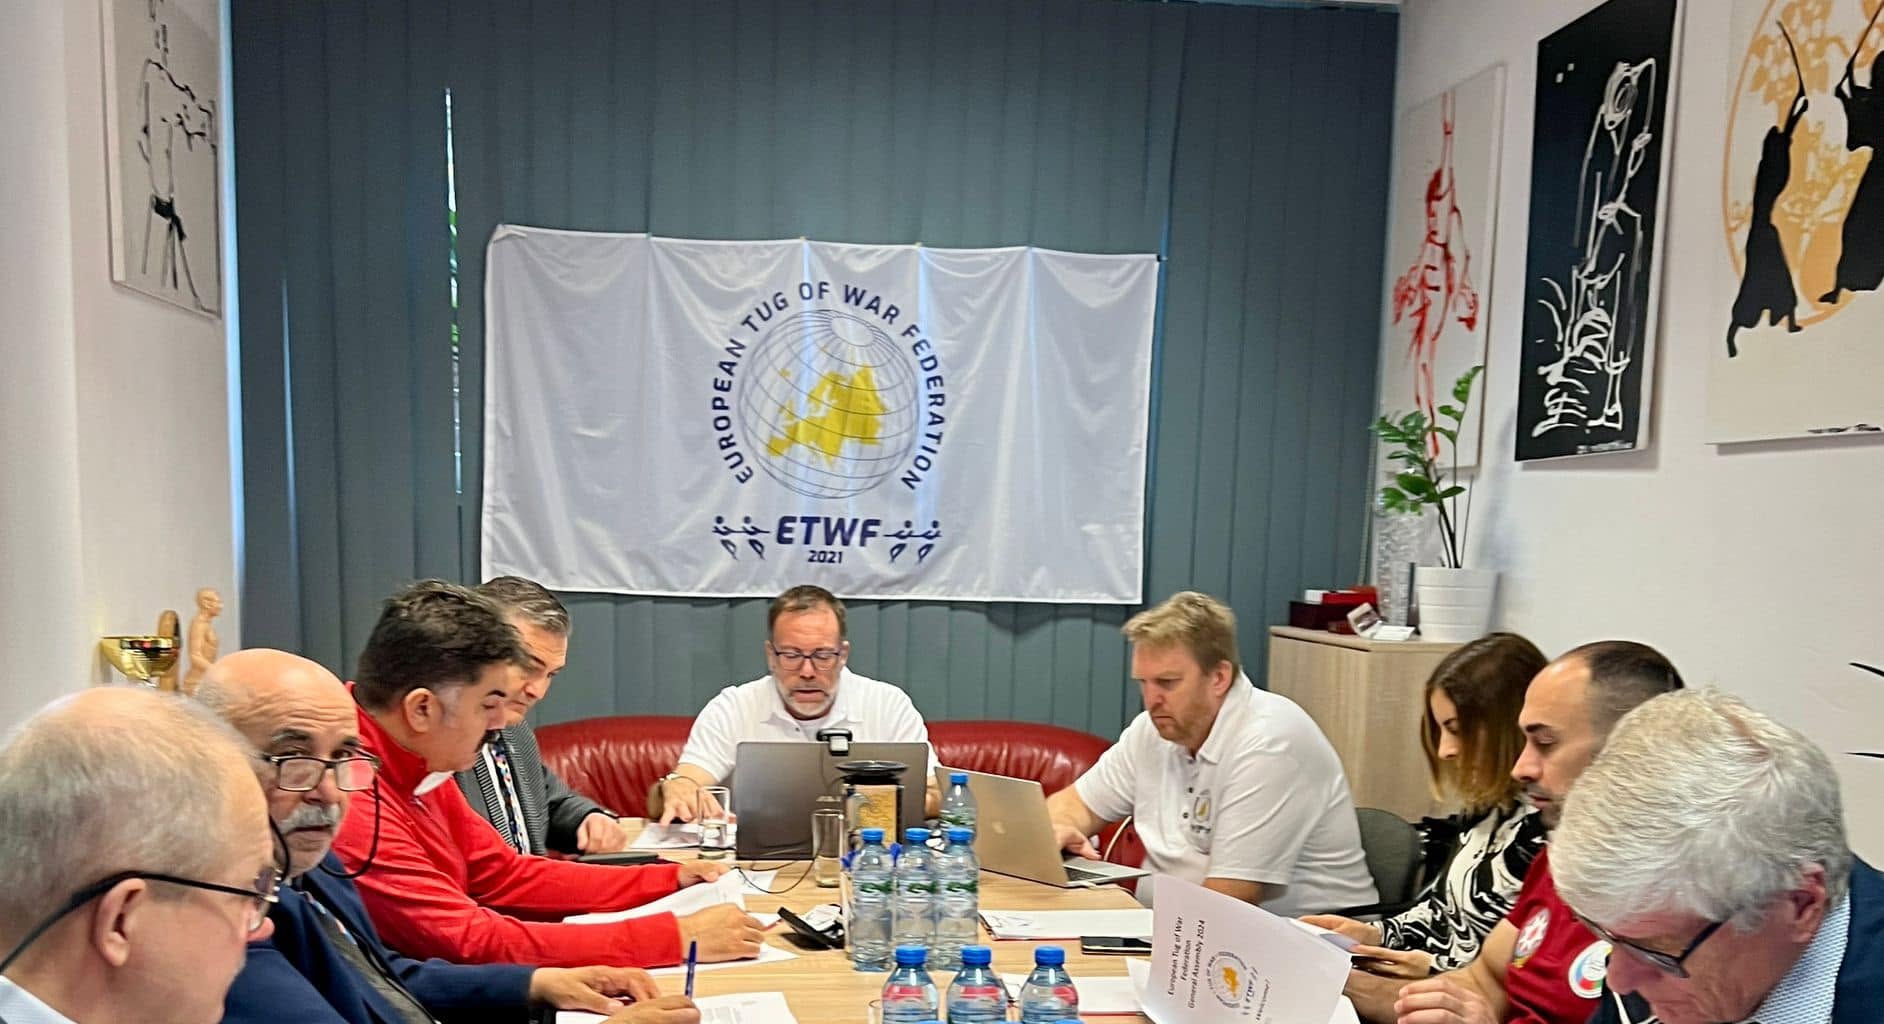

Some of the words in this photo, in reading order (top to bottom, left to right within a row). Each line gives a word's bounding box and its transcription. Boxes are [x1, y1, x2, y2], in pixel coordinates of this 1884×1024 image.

[711, 338, 755, 484] EUROPEAN
[741, 291, 790, 333] TUG
[799, 281, 831, 301] OF
[843, 284, 901, 325] WAR
[901, 323, 945, 490] FEDERATION
[776, 515, 882, 547] ETWF
[807, 550, 843, 564] 2021
[1168, 959, 1178, 995] European
[1180, 940, 1191, 981] Federation
[1187, 978, 1198, 1009] General
